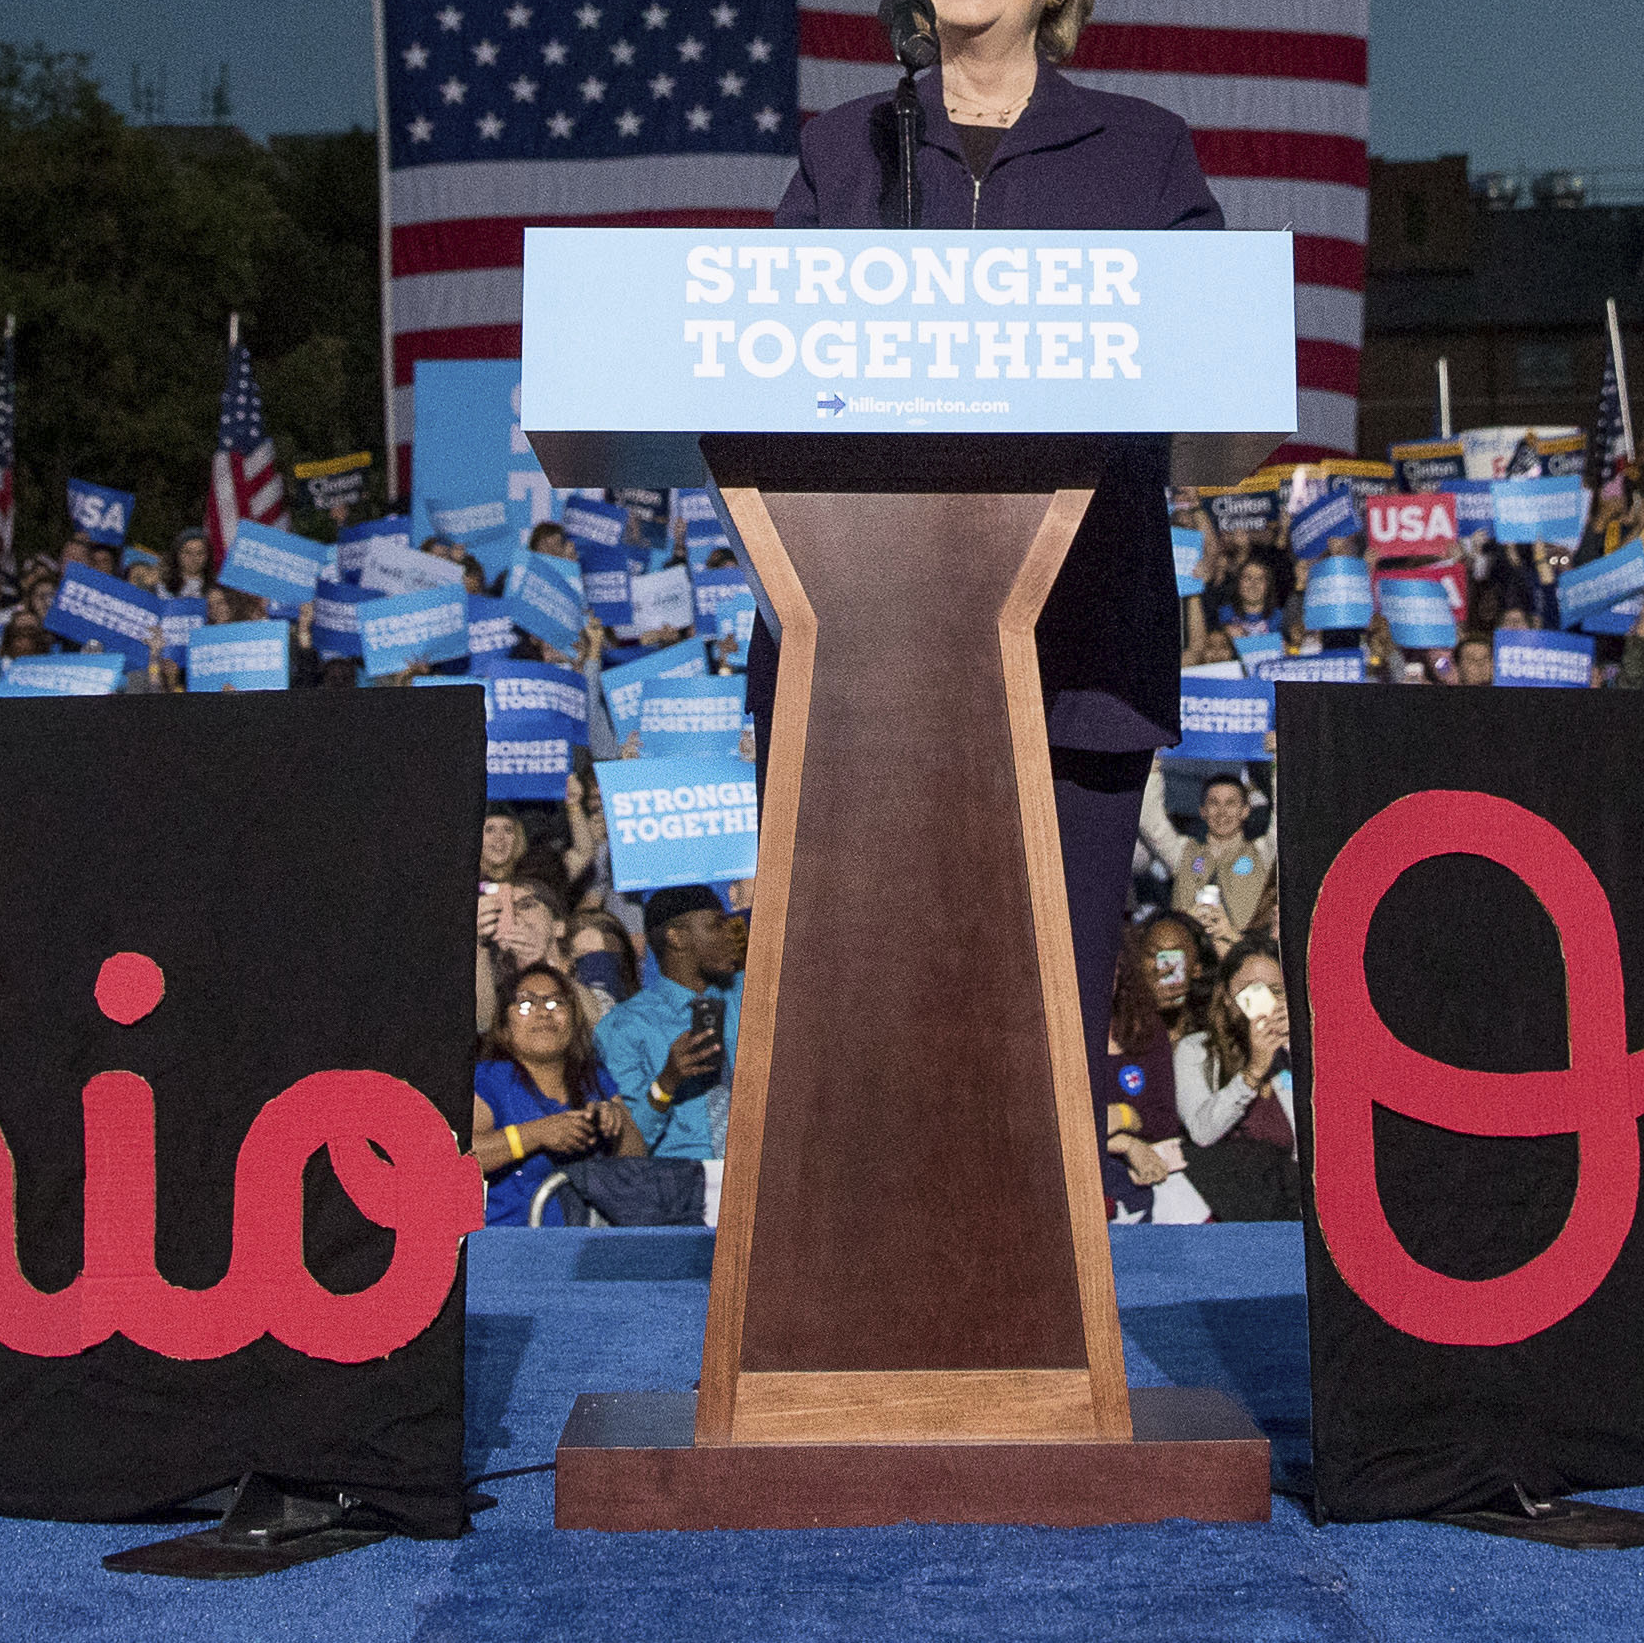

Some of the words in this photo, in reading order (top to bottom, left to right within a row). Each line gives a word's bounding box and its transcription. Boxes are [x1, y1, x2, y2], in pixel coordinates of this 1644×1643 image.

[685, 245, 1141, 306] STRONGER
[684, 319, 1142, 380] TOGETHER
[848, 396, 1010, 416] hillaryclinton.com
[1370, 505, 1455, 542] USA
[1181, 697, 1269, 714] TRONGER
[612, 782, 758, 817] STRONGE
[615, 807, 758, 845] TOGETHE
